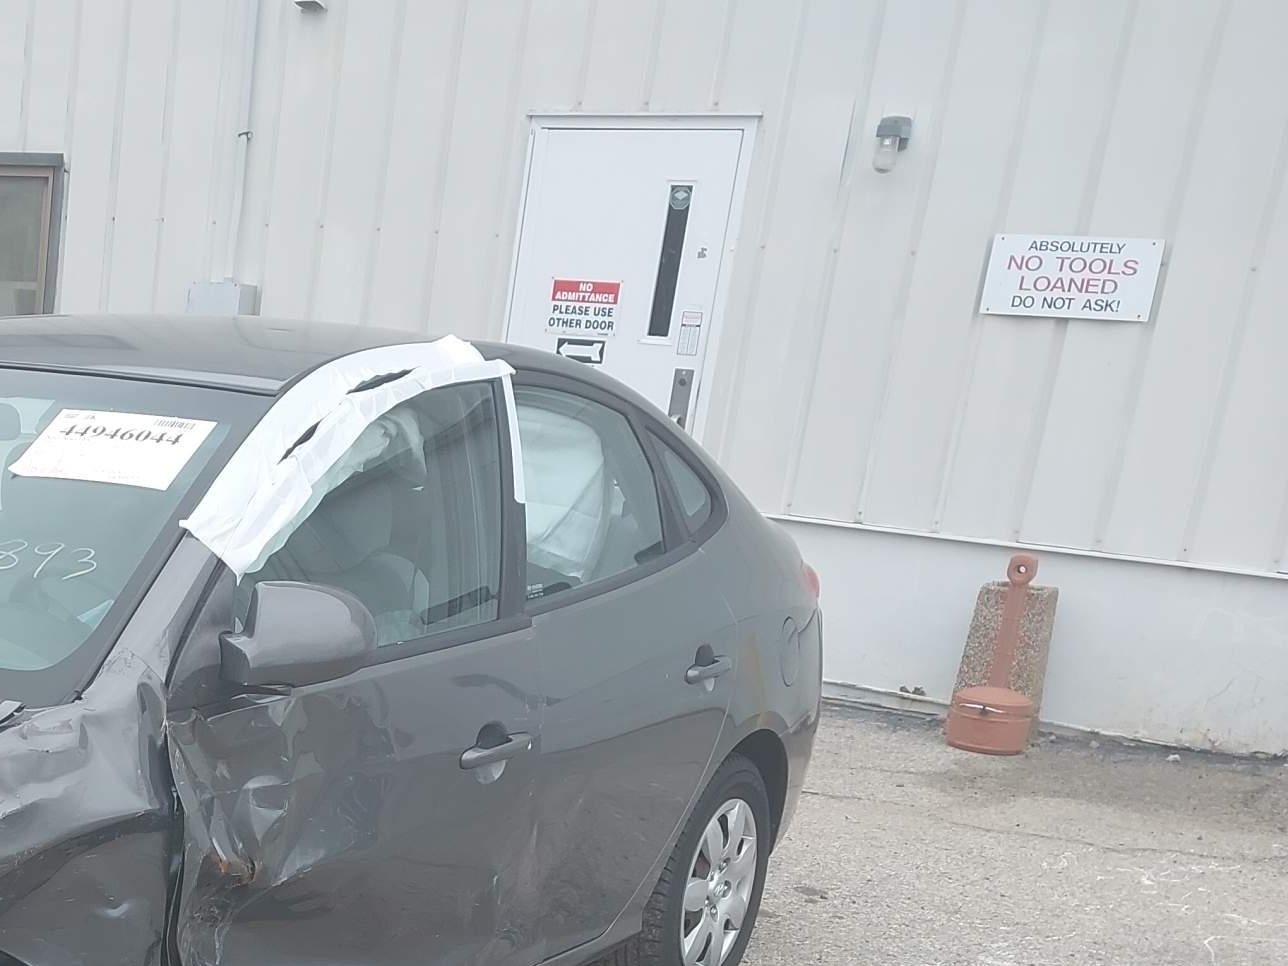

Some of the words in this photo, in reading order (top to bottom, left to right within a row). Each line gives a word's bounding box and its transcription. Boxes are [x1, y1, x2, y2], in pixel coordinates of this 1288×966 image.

[1028, 240, 1126, 254] ABSOLUTELY
[1007, 255, 1043, 272] NO
[1056, 256, 1139, 276] TOOLS
[579, 282, 594, 292] NO
[1018, 275, 1118, 295] LOANED
[554, 291, 616, 303] ADMITTANCE
[1011, 295, 1035, 309] DO
[1041, 296, 1075, 311] NOT
[1081, 298, 1121, 313] ASK!
[552, 304, 591, 316] PLEASE
[593, 306, 614, 317] USE
[548, 316, 582, 329] OTHER
[584, 319, 615, 331] DOOR
[59, 423, 183, 446] 44946044
